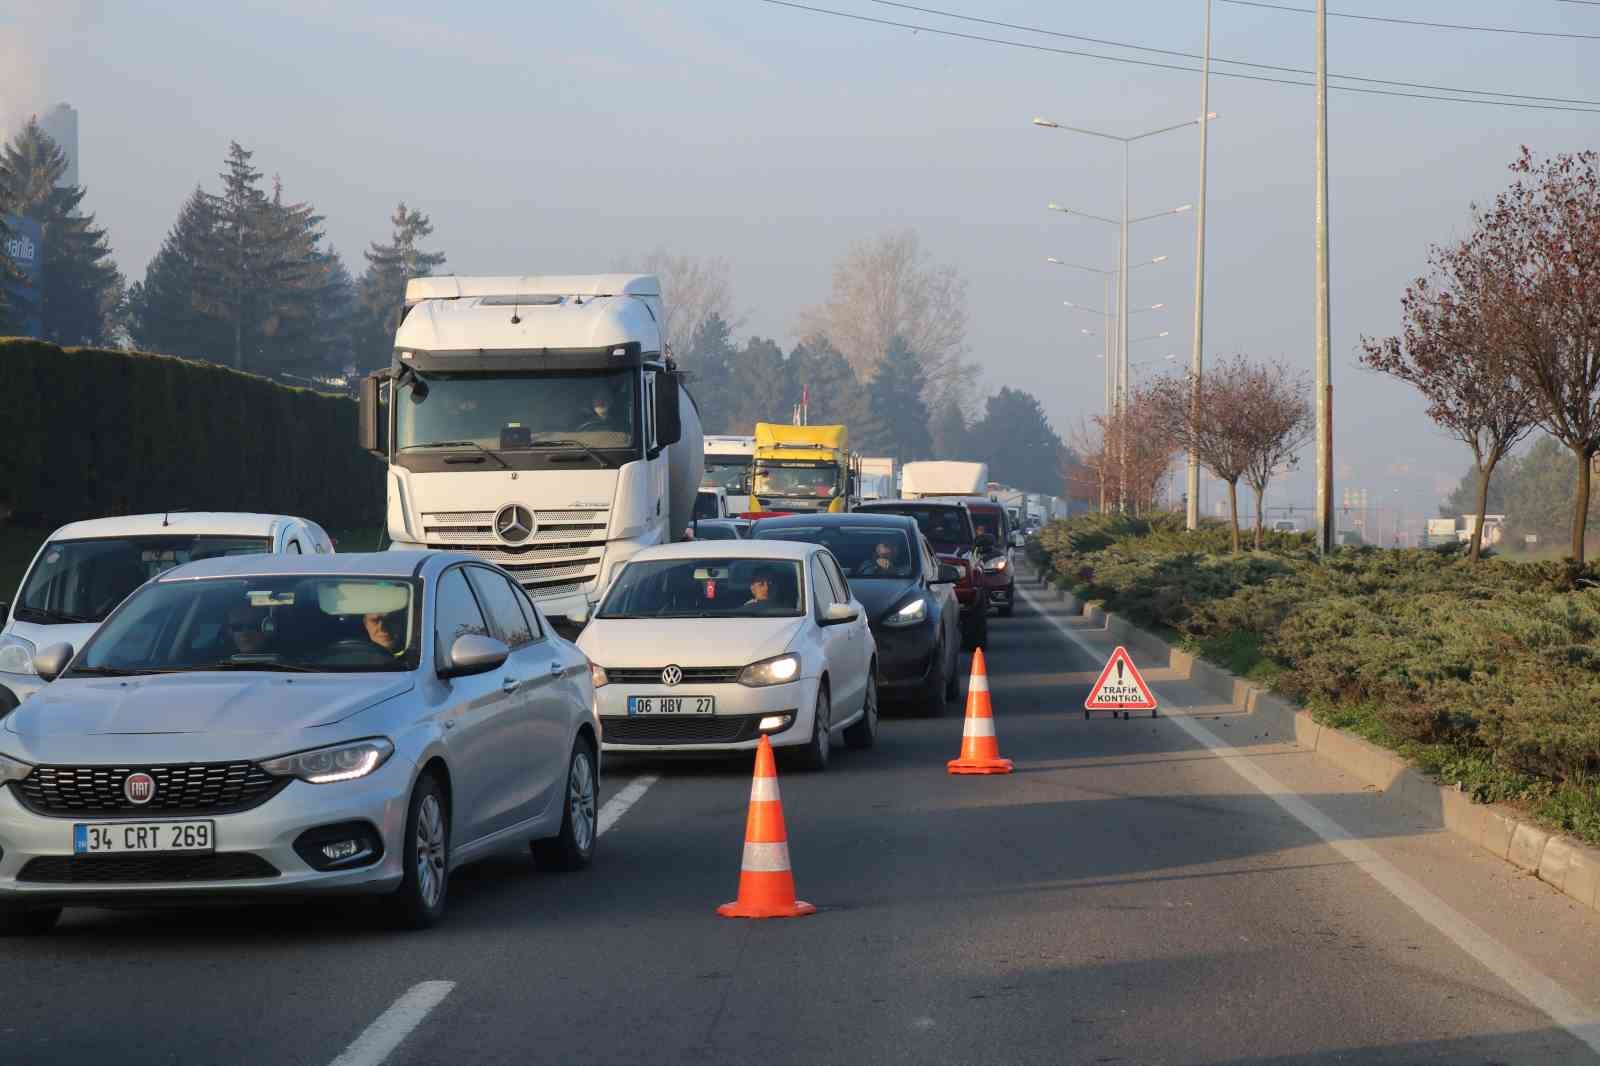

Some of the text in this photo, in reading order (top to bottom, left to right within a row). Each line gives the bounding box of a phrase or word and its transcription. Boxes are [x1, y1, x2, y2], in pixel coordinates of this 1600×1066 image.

[1103, 686, 1138, 694] TRAFIK
[637, 699, 652, 713] 06
[660, 698, 683, 713] HBV
[696, 698, 711, 713] 27
[1097, 694, 1144, 702] KONTROL
[131, 782, 149, 797] FIAT
[89, 825, 208, 850] 34 CRT 269
